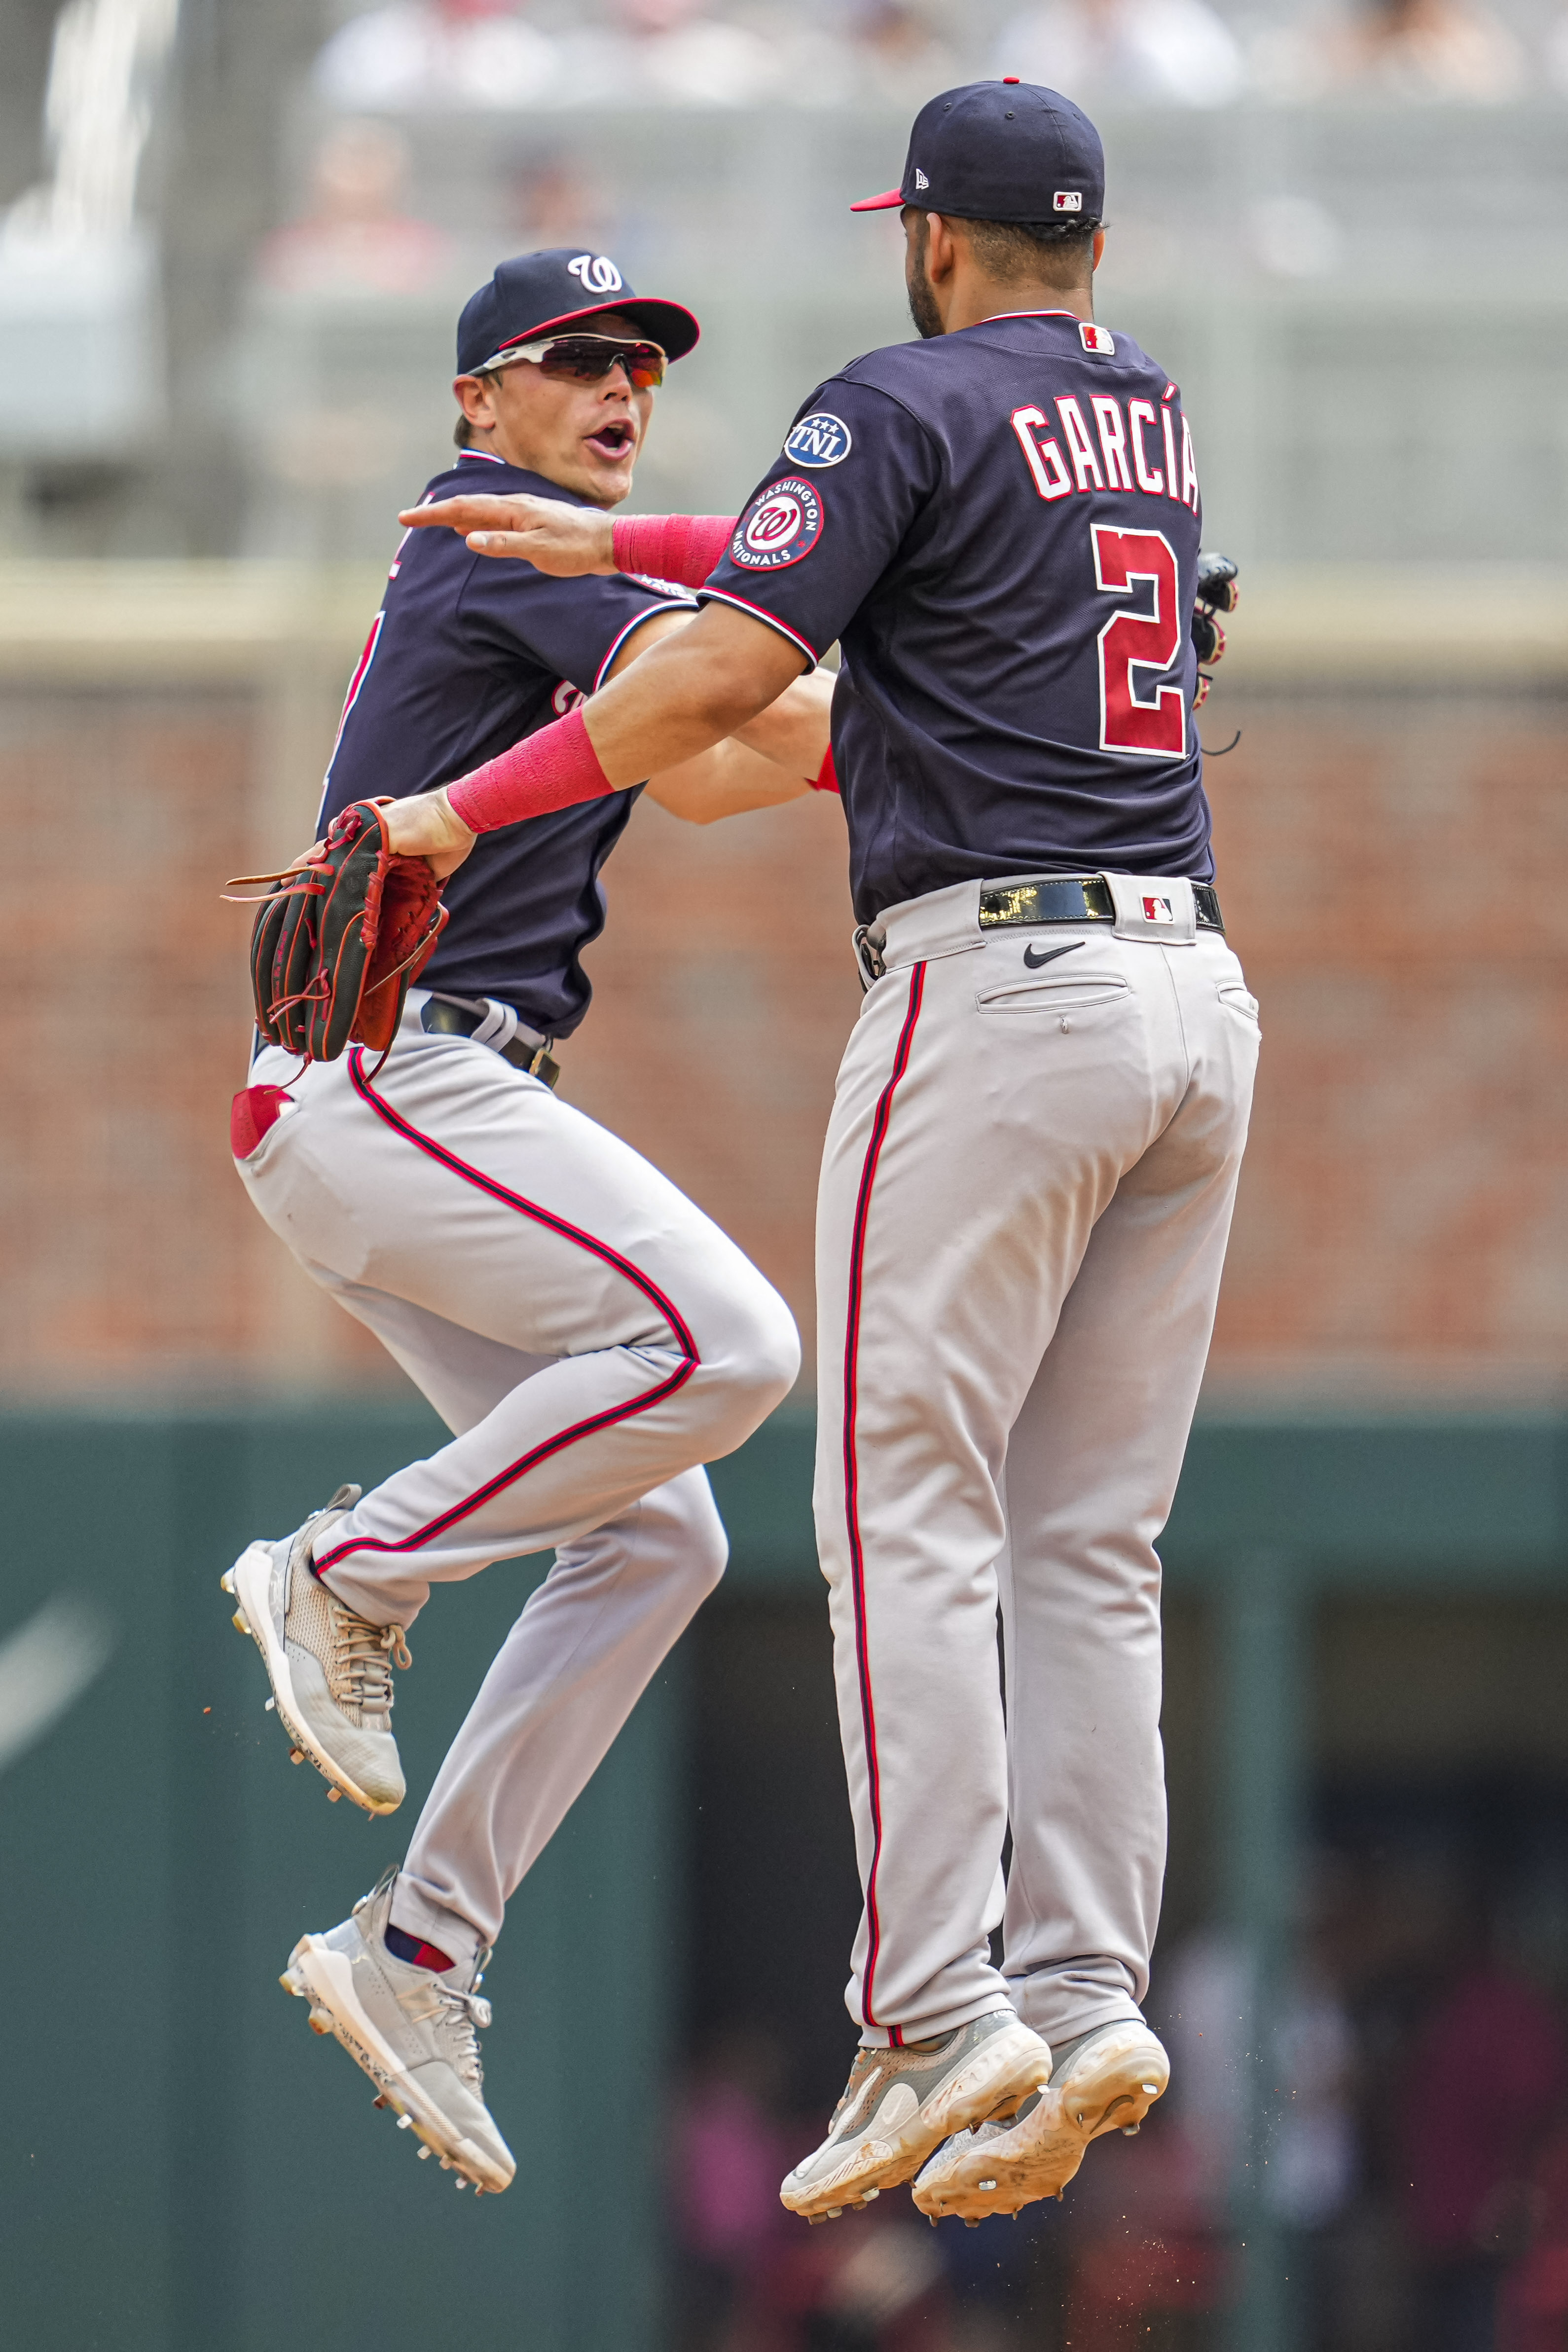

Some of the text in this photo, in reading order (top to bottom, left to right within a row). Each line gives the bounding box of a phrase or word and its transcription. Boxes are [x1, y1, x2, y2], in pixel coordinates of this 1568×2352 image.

[567, 255, 623, 294] W
[789, 425, 841, 462] TNL
[1010, 382, 1198, 517] GARCÍA
[751, 506, 798, 541] W
[755, 481, 818, 531] WASHINGTON
[733, 530, 791, 565] NATIONALS
[1090, 523, 1189, 760] 2
